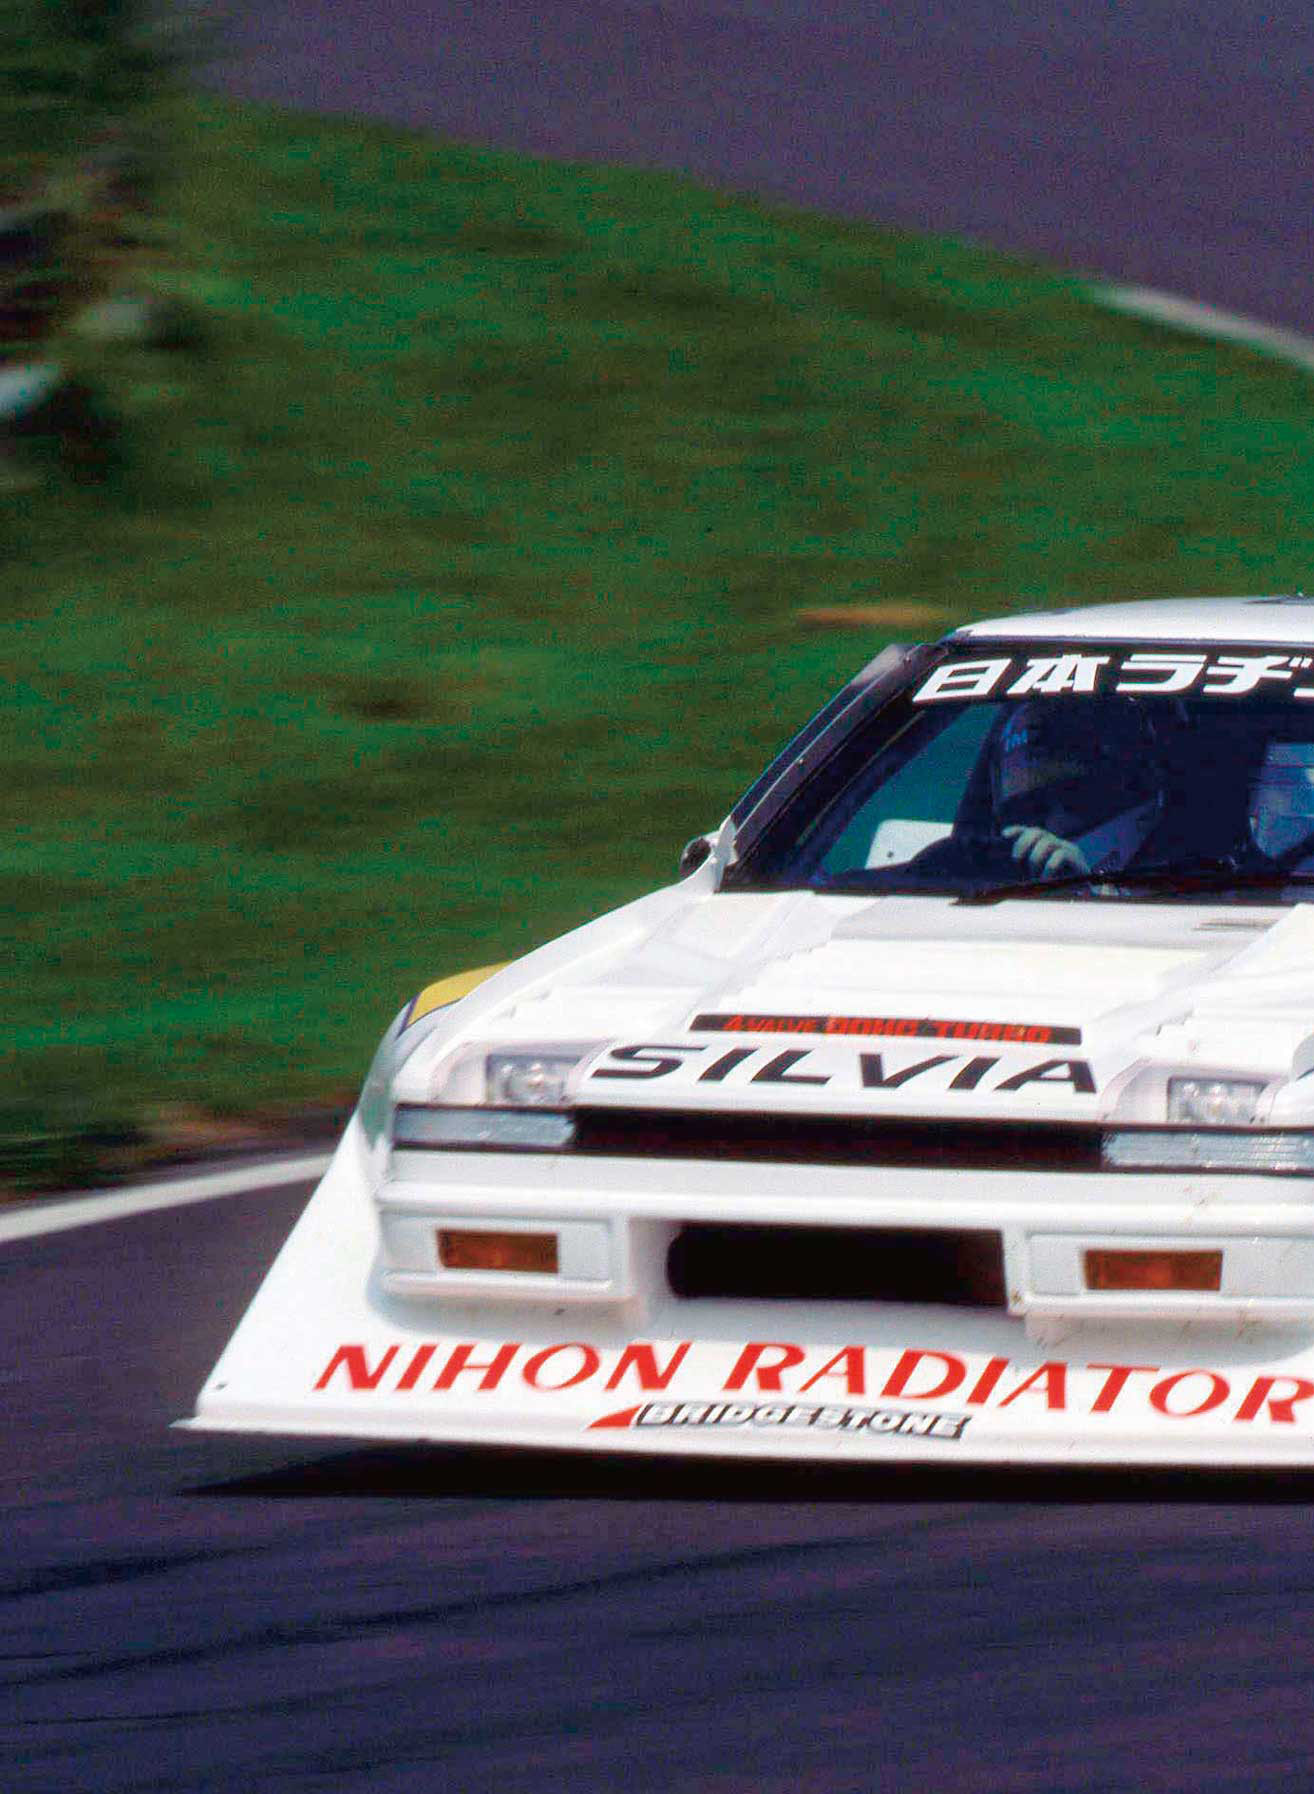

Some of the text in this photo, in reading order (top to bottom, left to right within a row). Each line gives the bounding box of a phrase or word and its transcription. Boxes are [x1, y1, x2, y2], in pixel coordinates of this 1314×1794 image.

[591, 1045, 1097, 1094] SILVIA
[315, 1342, 692, 1391] NIHON
[640, 1402, 970, 1440] BRIDGESTONE
